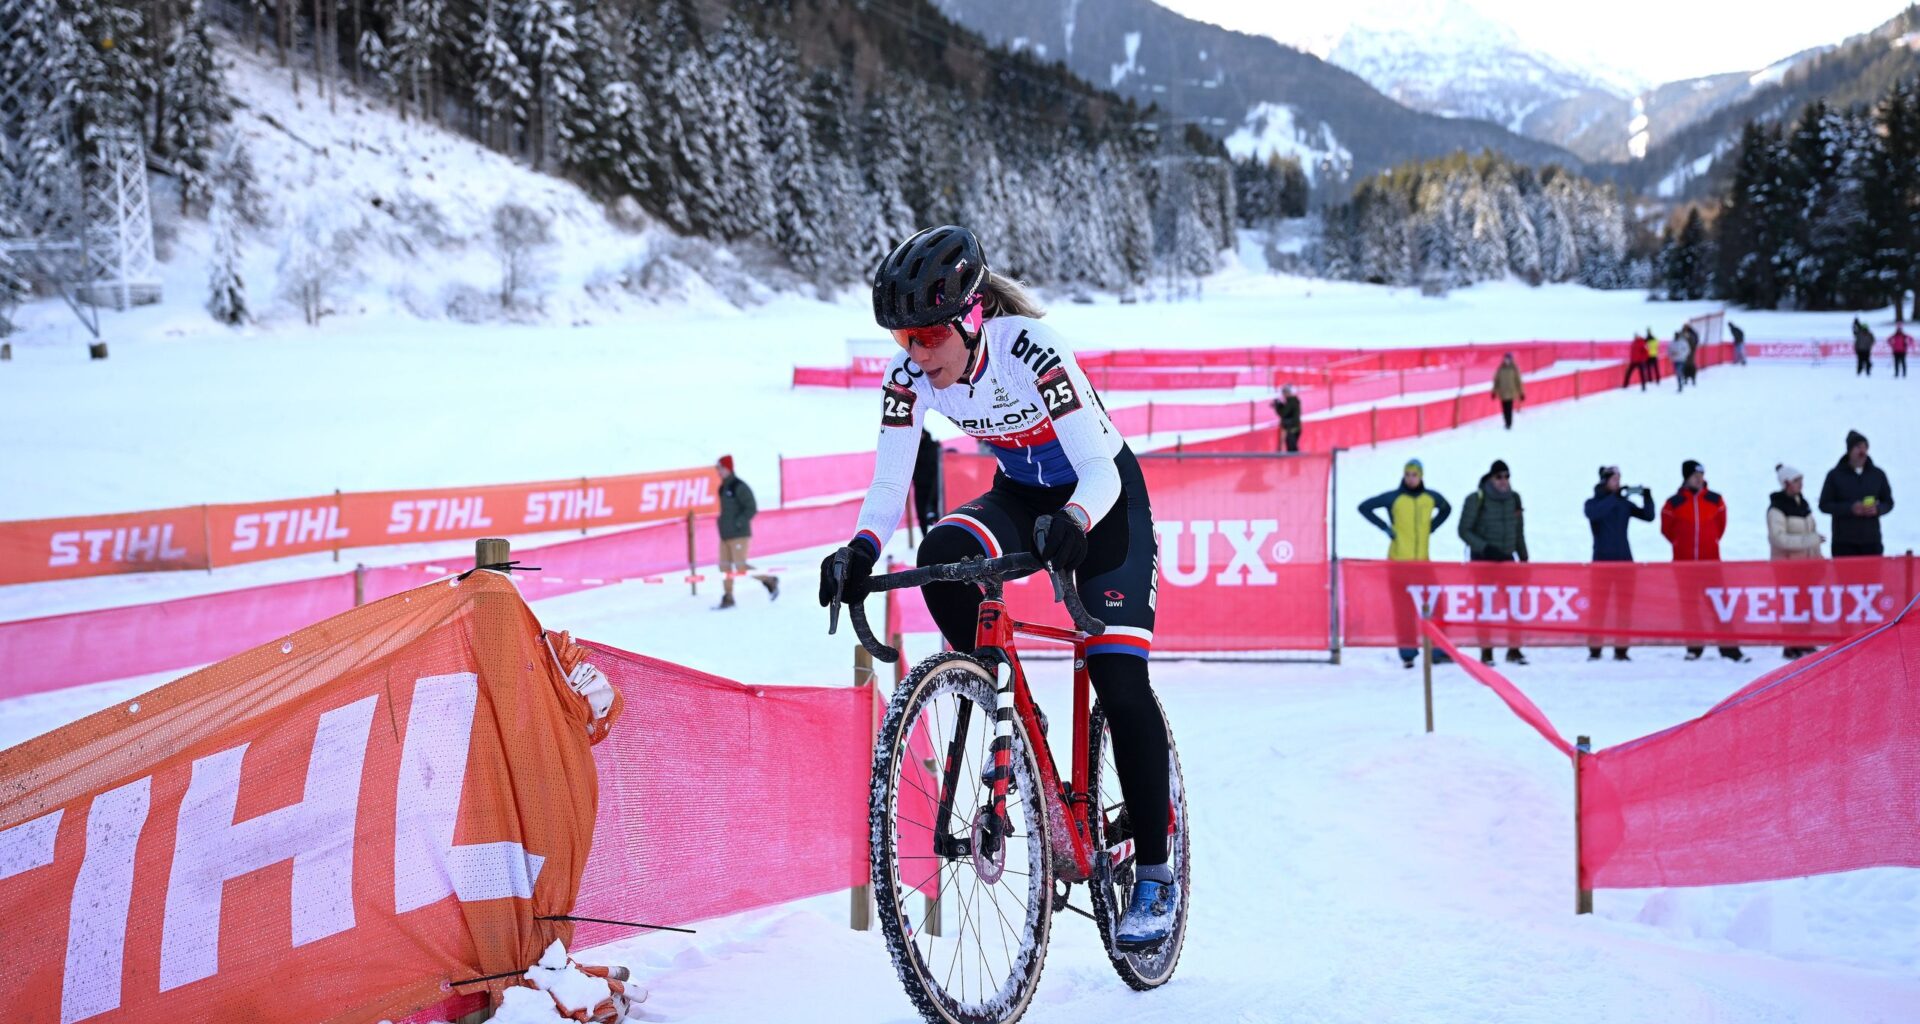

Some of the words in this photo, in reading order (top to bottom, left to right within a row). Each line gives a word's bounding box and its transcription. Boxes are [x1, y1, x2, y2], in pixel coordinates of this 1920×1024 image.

[1011, 329, 1061, 377] bril
[885, 396, 911, 417] 25
[1043, 381, 1073, 411] 25
[990, 424, 1025, 433] TEAM
[48, 524, 187, 567] STIHL
[230, 506, 350, 551] STIHL
[386, 497, 494, 534] STIHL
[523, 487, 613, 525] STIHL
[638, 476, 717, 513] STIHL
[0, 671, 546, 1024] IHL
